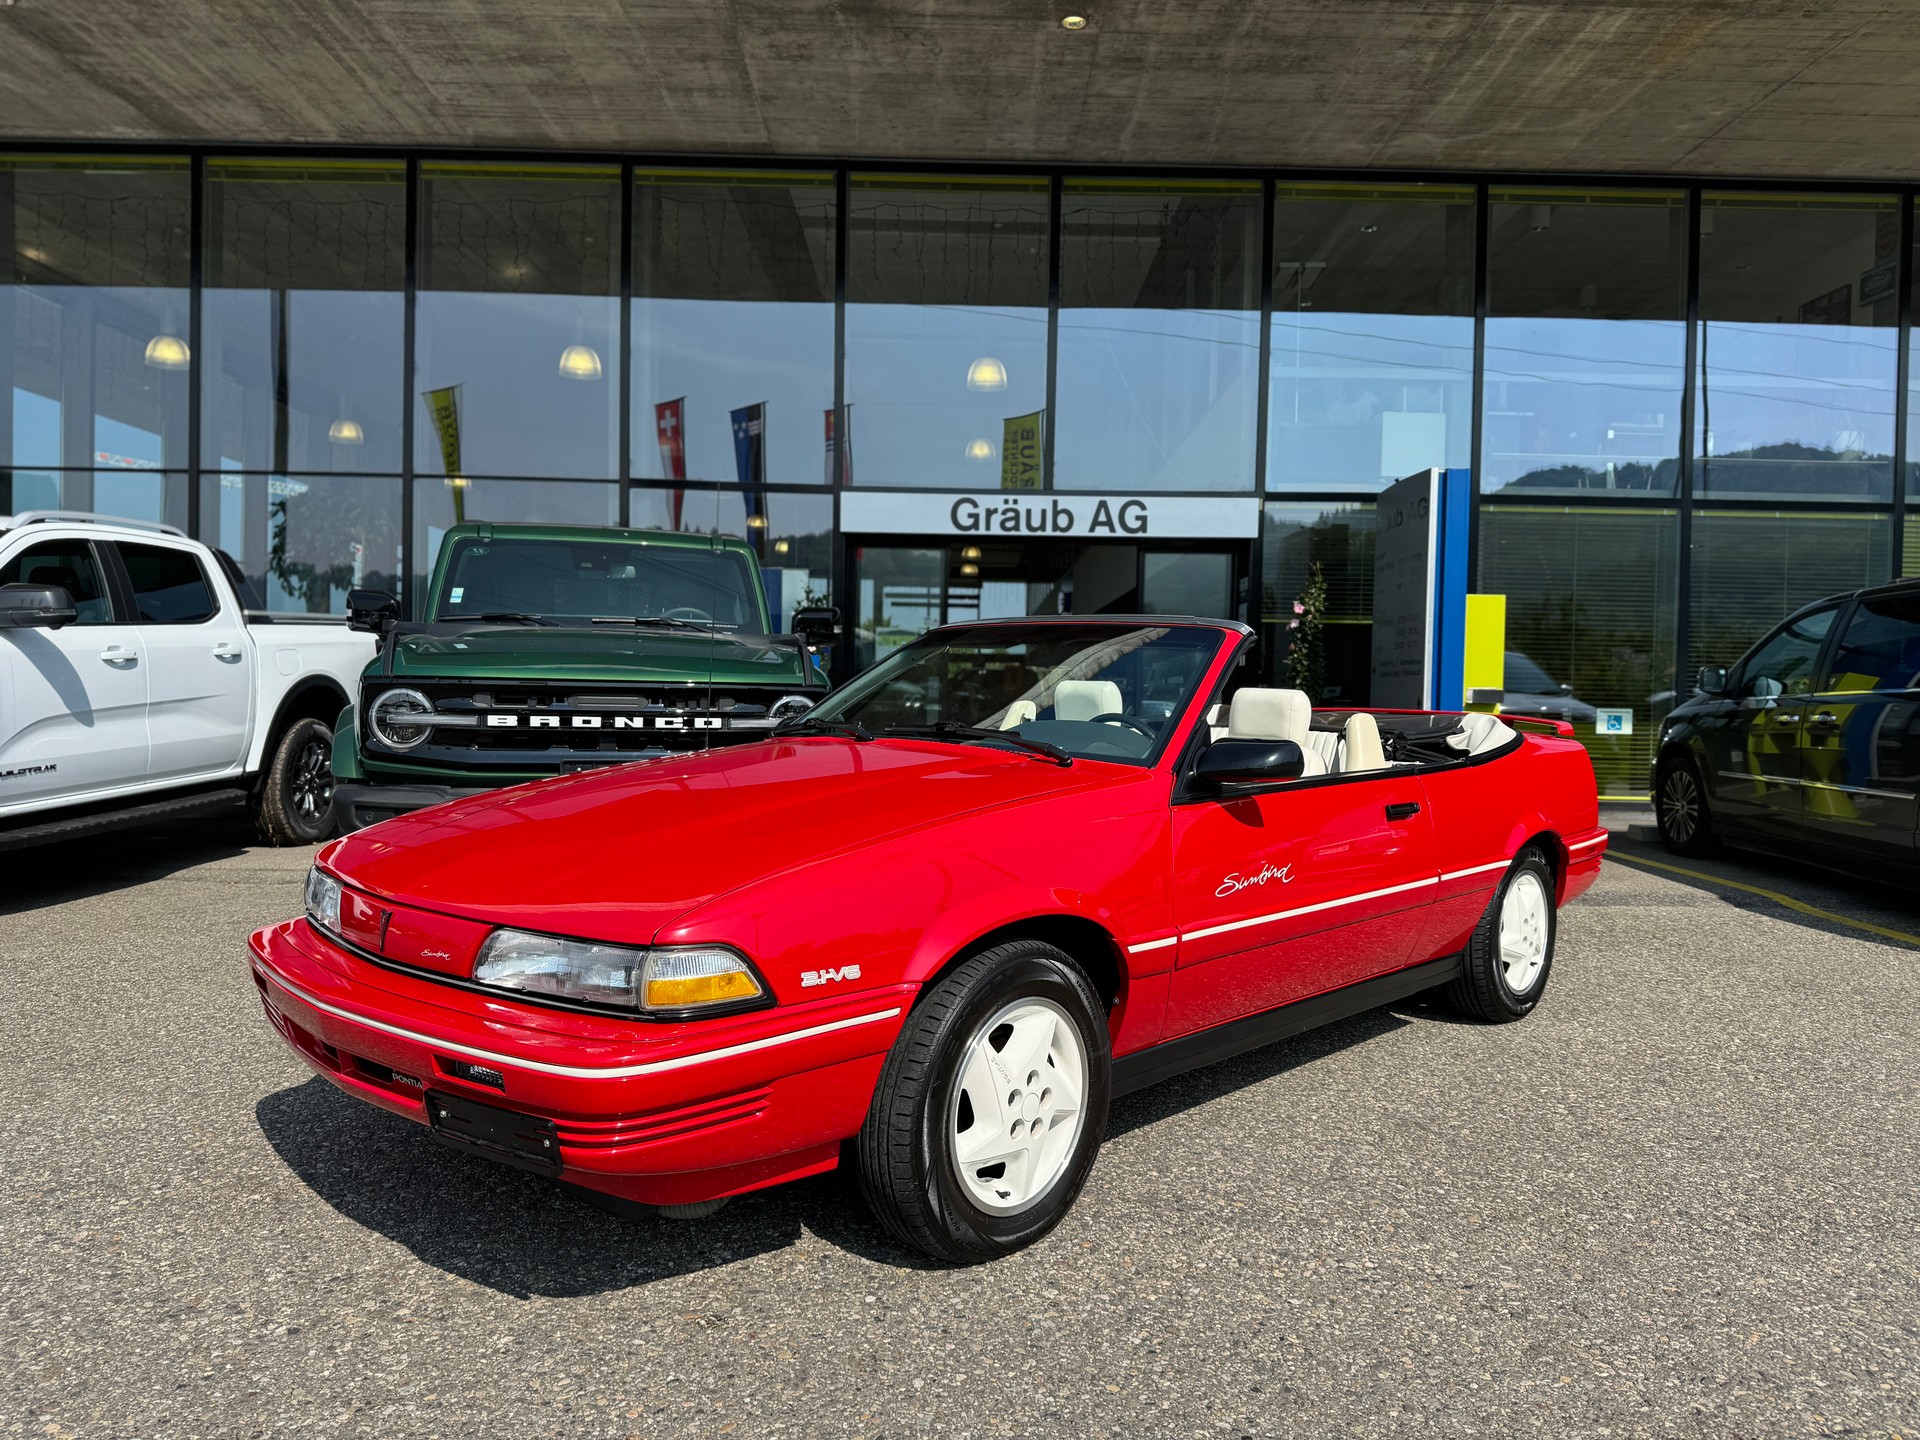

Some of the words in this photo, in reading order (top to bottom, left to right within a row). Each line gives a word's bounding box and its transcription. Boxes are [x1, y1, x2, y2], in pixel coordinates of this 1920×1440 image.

[951, 497, 1075, 533] Gräub
[1088, 499, 1148, 534] AG
[487, 715, 722, 729] BRONCO
[1215, 863, 1295, 898] Sunbird
[391, 1072, 424, 1090] PONTIA
